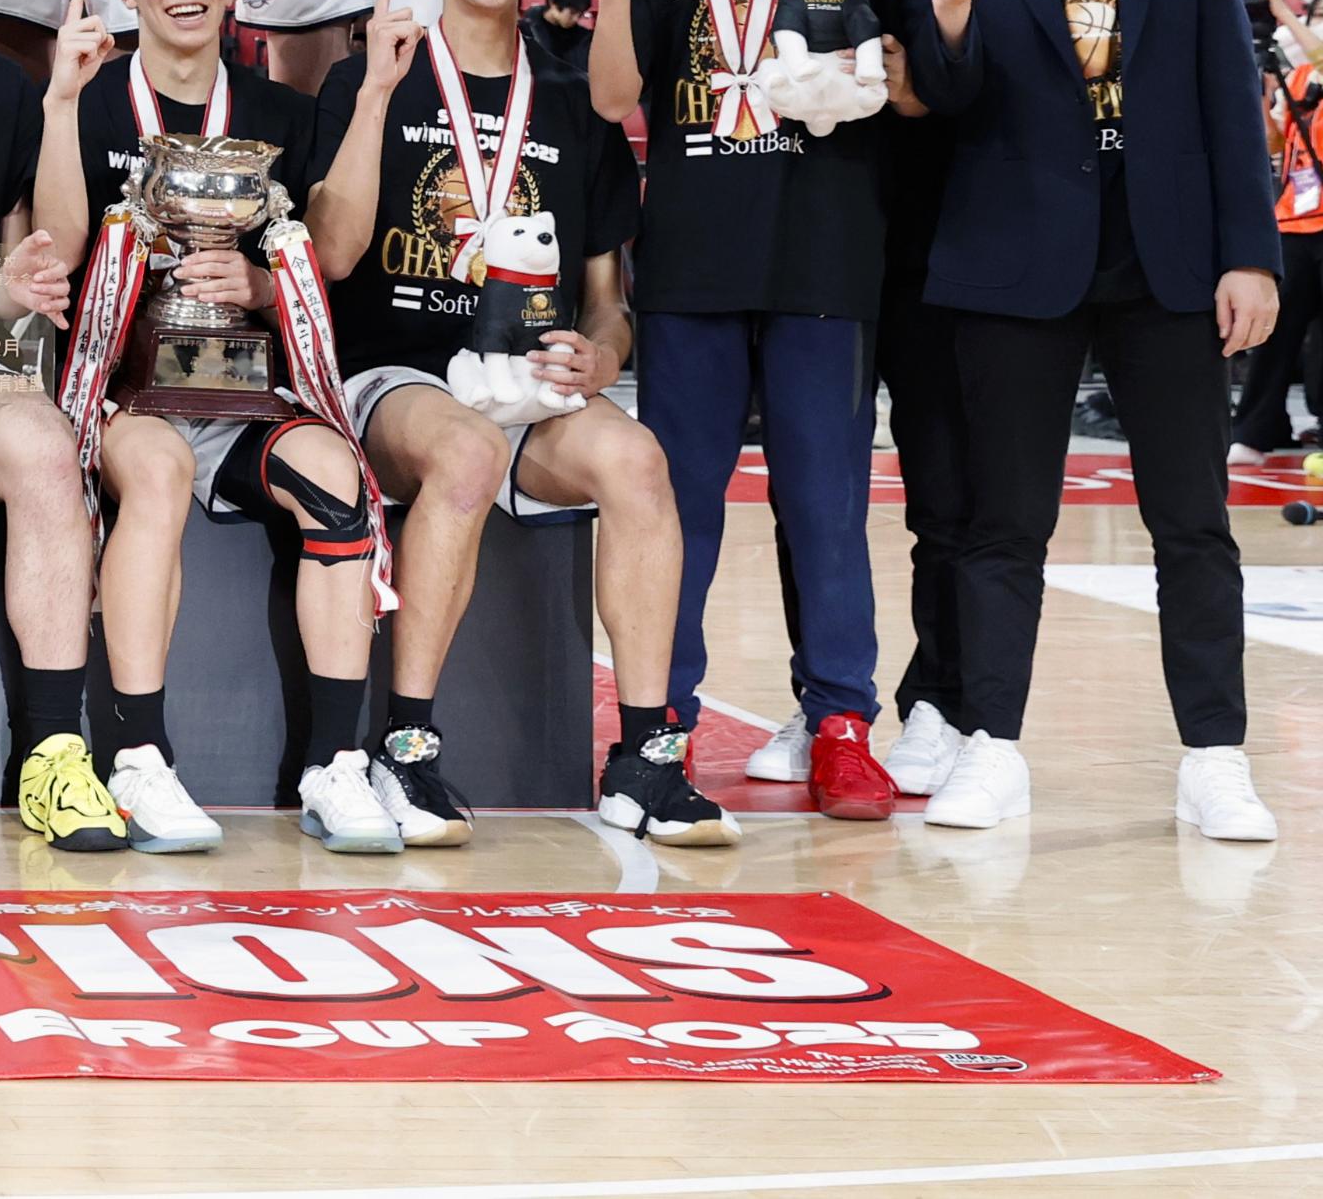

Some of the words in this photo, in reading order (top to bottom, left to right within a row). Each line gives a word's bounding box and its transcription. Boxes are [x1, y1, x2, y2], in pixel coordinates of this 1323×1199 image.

[209, 1016, 531, 1051] CUP
[545, 1009, 982, 1052] 2025
[807, 1051, 855, 1061] The
[703, 1057, 776, 1068] Japan
[781, 1058, 841, 1069] High
